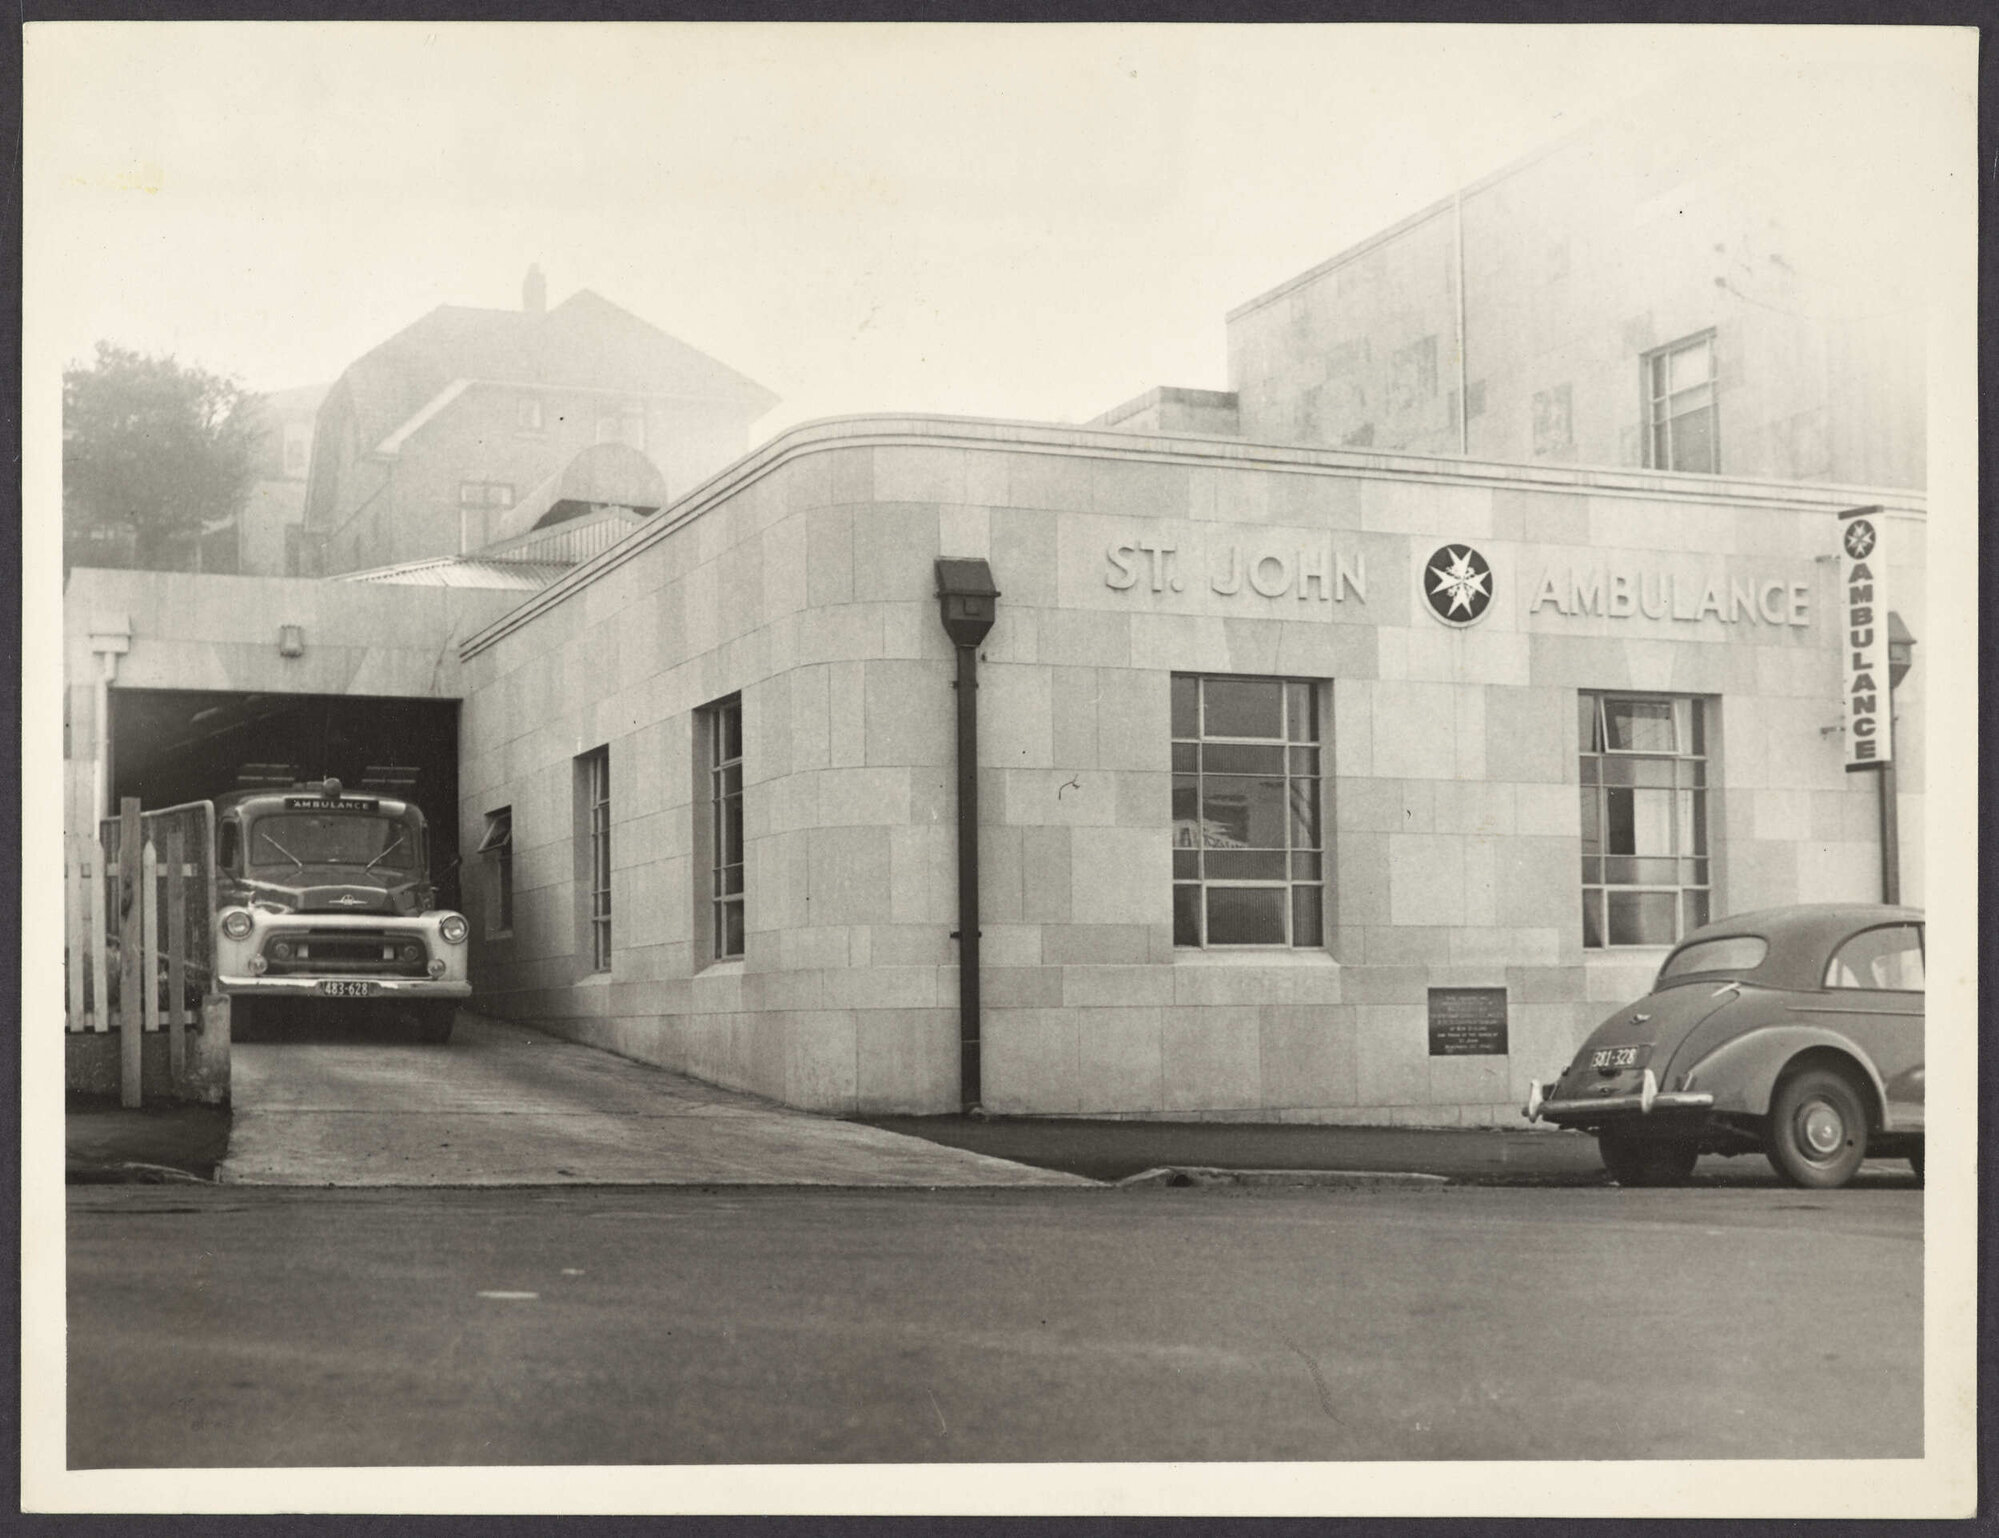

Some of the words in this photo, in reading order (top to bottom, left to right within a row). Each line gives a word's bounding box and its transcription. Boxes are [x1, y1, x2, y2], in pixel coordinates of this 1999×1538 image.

[1105, 542, 1184, 592] ST.
[1209, 545, 1368, 604] JOHN
[1529, 563, 1811, 628] AMBULANCE
[1848, 562, 1877, 761] AMBULANCE
[294, 800, 369, 810] AMBULANCE
[325, 982, 368, 996] 483-628
